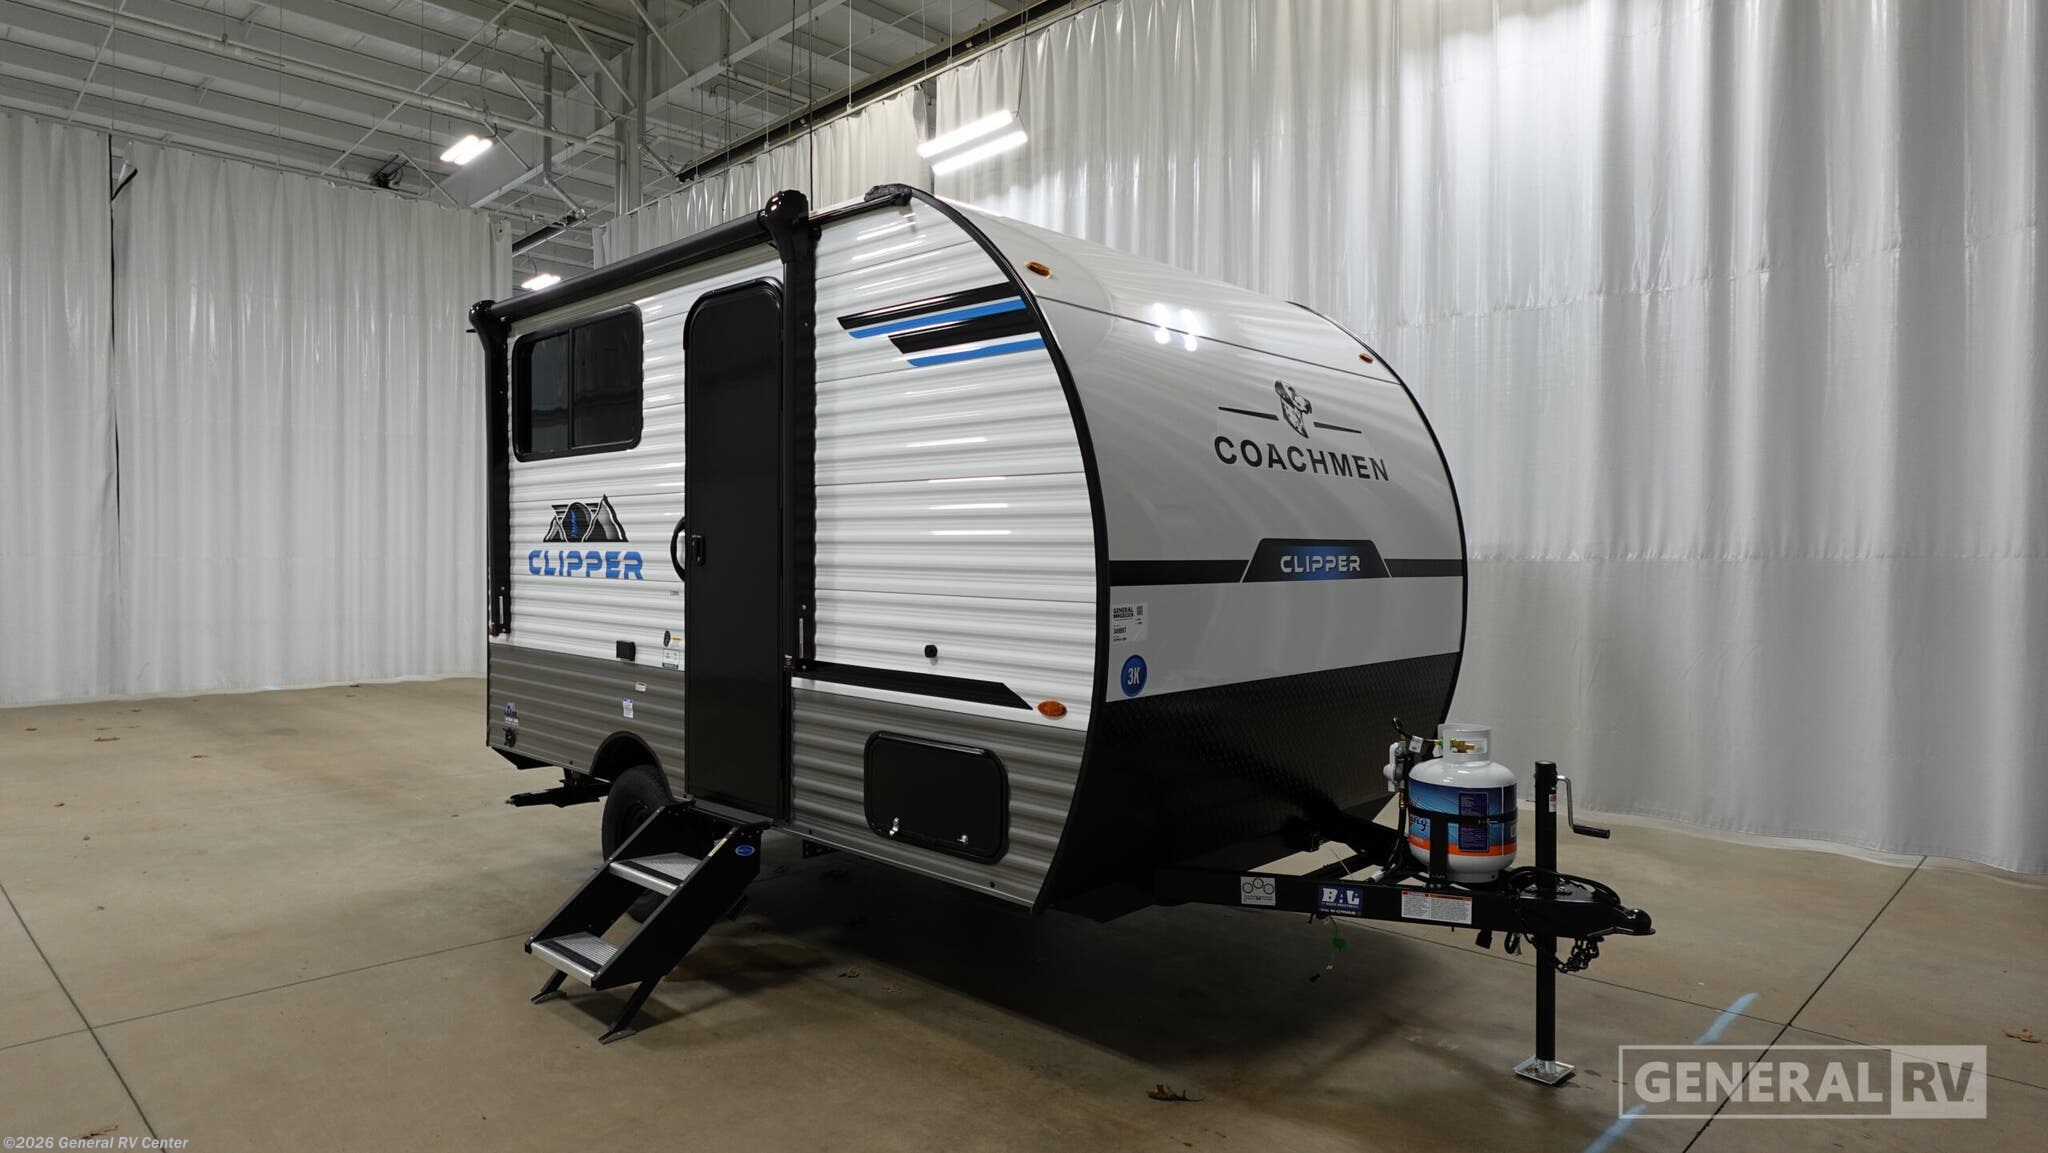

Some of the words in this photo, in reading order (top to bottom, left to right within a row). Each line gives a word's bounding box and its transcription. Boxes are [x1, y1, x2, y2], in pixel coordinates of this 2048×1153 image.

[1214, 436, 1389, 481] COACHMEN
[528, 549, 644, 580] CLIPPER
[1280, 555, 1361, 574] CLIPPER
[1127, 667, 1140, 685] 3K
[1321, 887, 1360, 905] BAL
